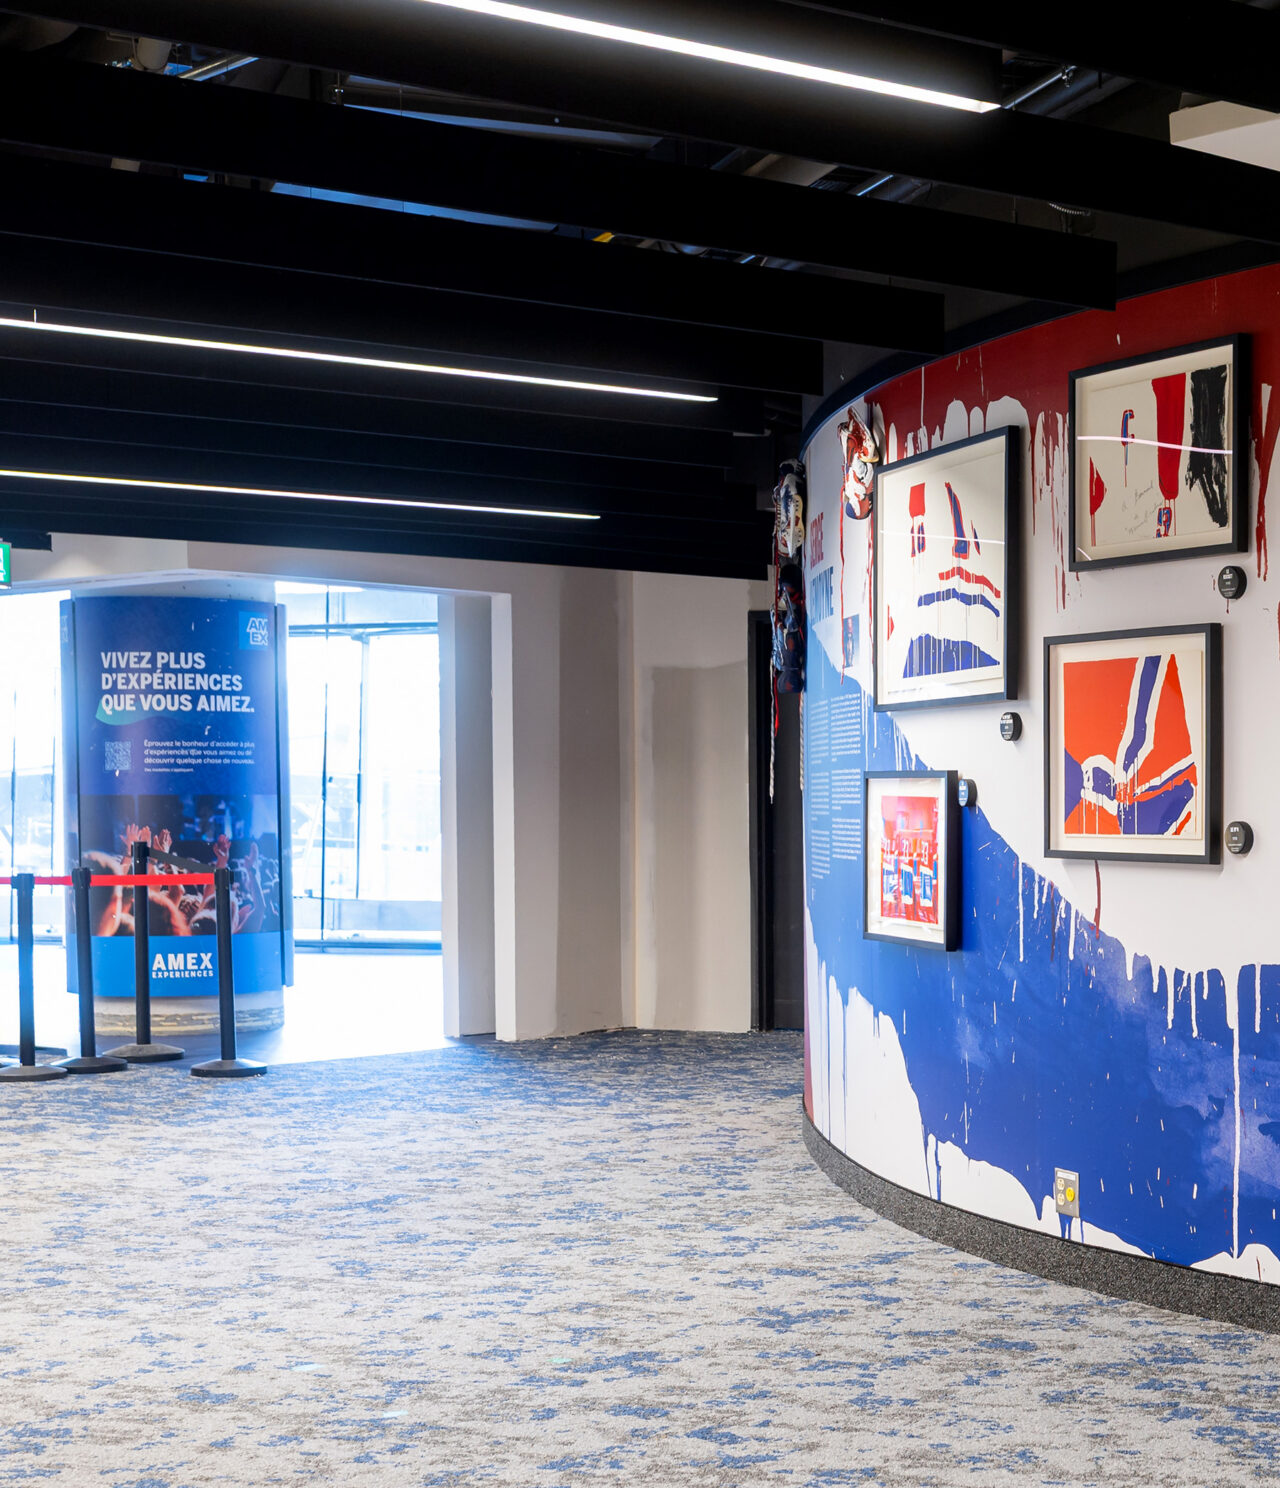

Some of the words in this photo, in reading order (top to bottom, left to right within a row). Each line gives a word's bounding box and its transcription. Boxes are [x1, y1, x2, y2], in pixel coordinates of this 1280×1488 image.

[101, 652, 151, 669] VIVEZ
[157, 652, 206, 669] PLUS
[102, 669, 243, 691] D'EXPÉRIENCES
[102, 694, 136, 715] QUE
[139, 694, 192, 711] VOUS
[197, 695, 255, 712] AIMEZ.
[176, 757, 202, 765] quelque
[152, 953, 213, 970] AMEX
[152, 970, 214, 979] EXPERIENCES
